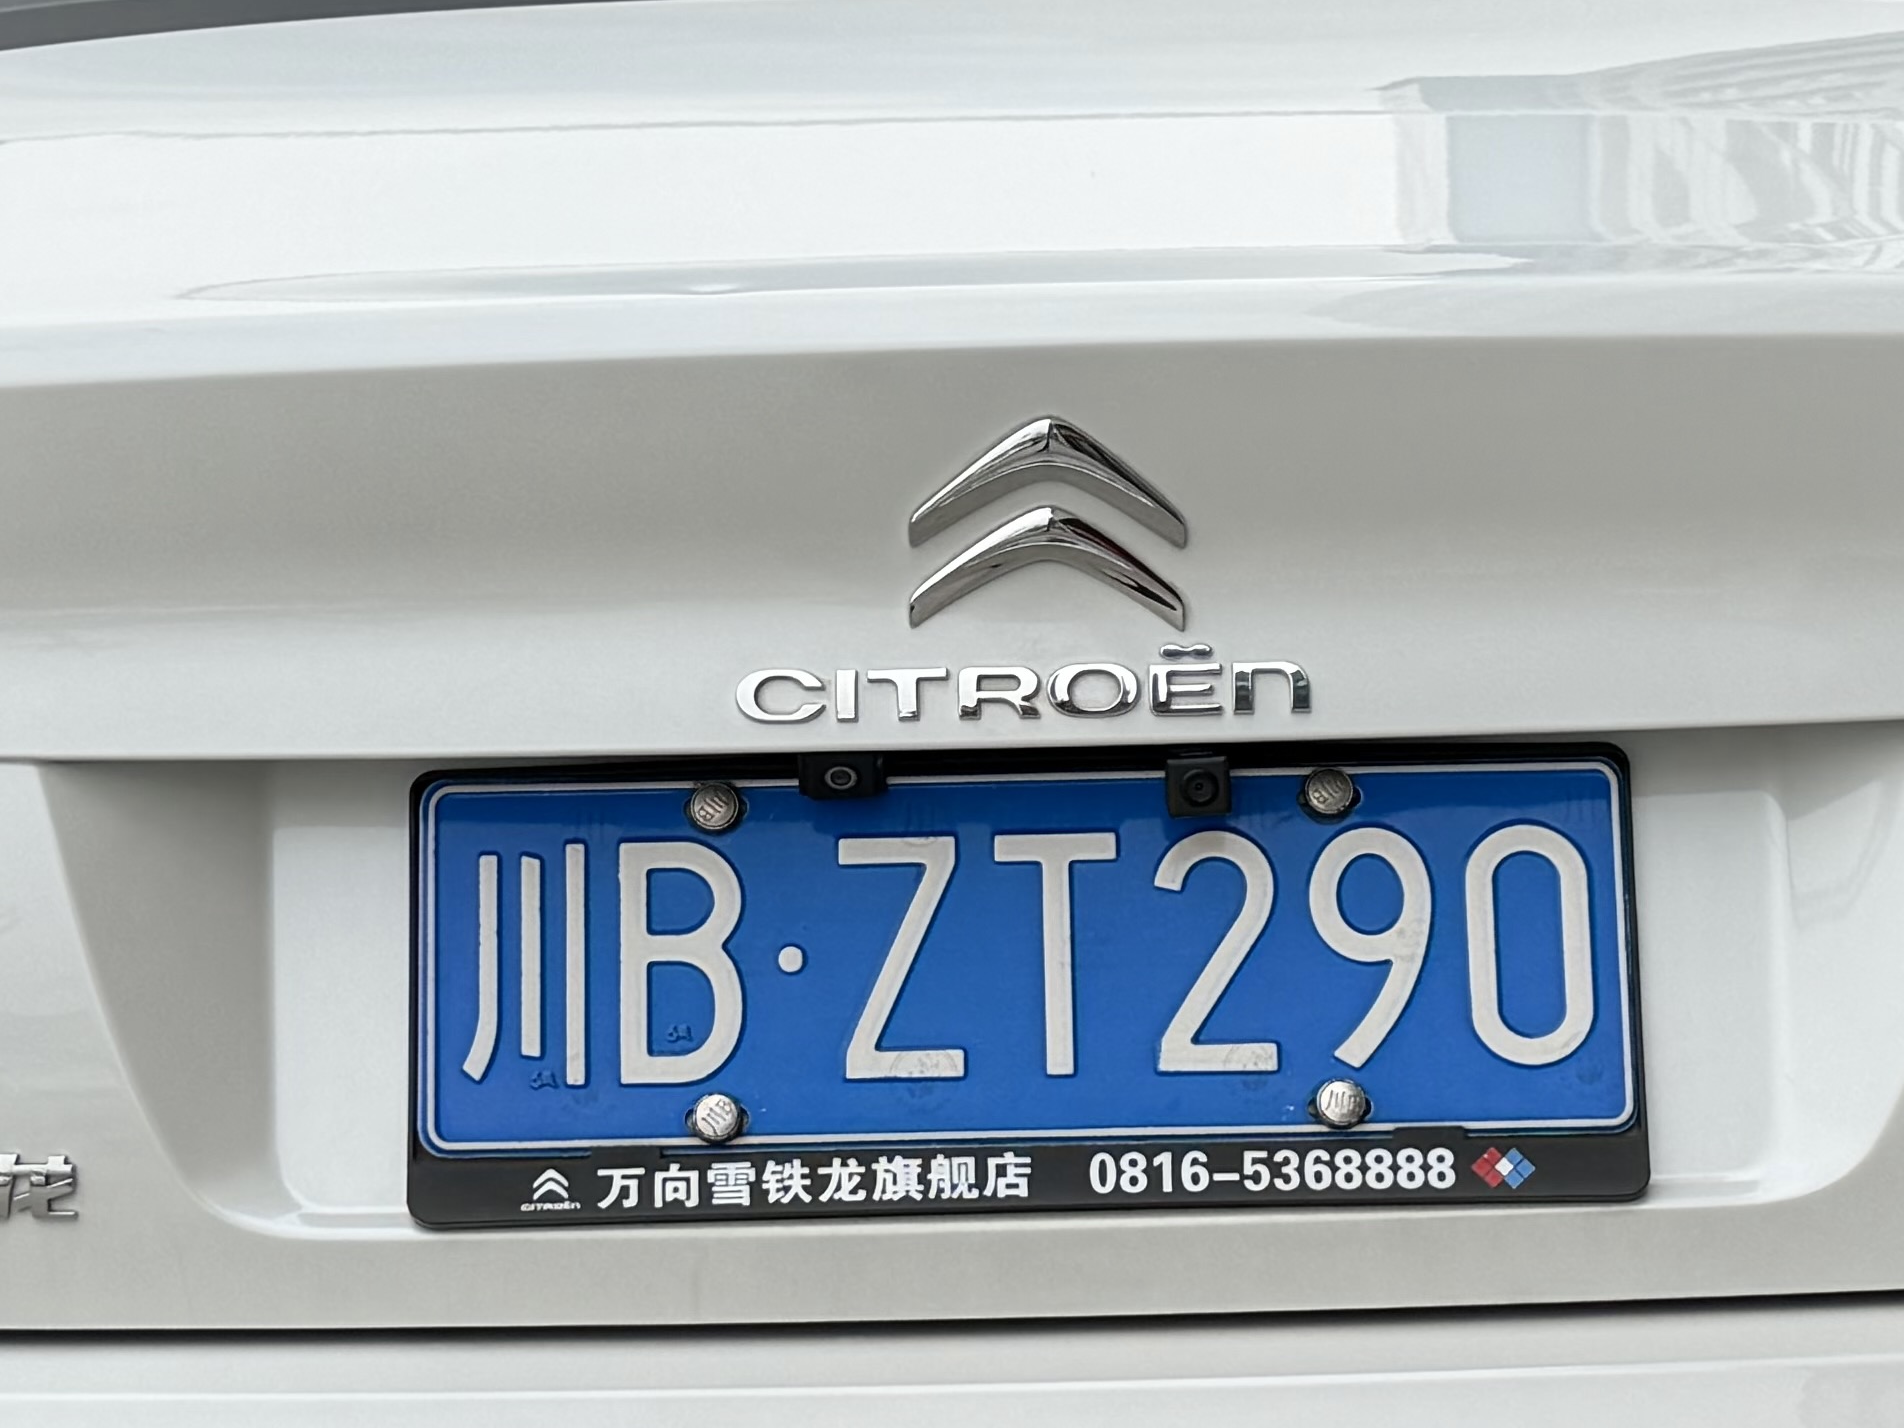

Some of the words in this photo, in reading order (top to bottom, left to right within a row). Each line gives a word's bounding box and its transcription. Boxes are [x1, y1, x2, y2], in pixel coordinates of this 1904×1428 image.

[597, 1154, 1032, 1210] 万向雪铁龙旗舰店
[1089, 1147, 1456, 1194] 0816-5368888
